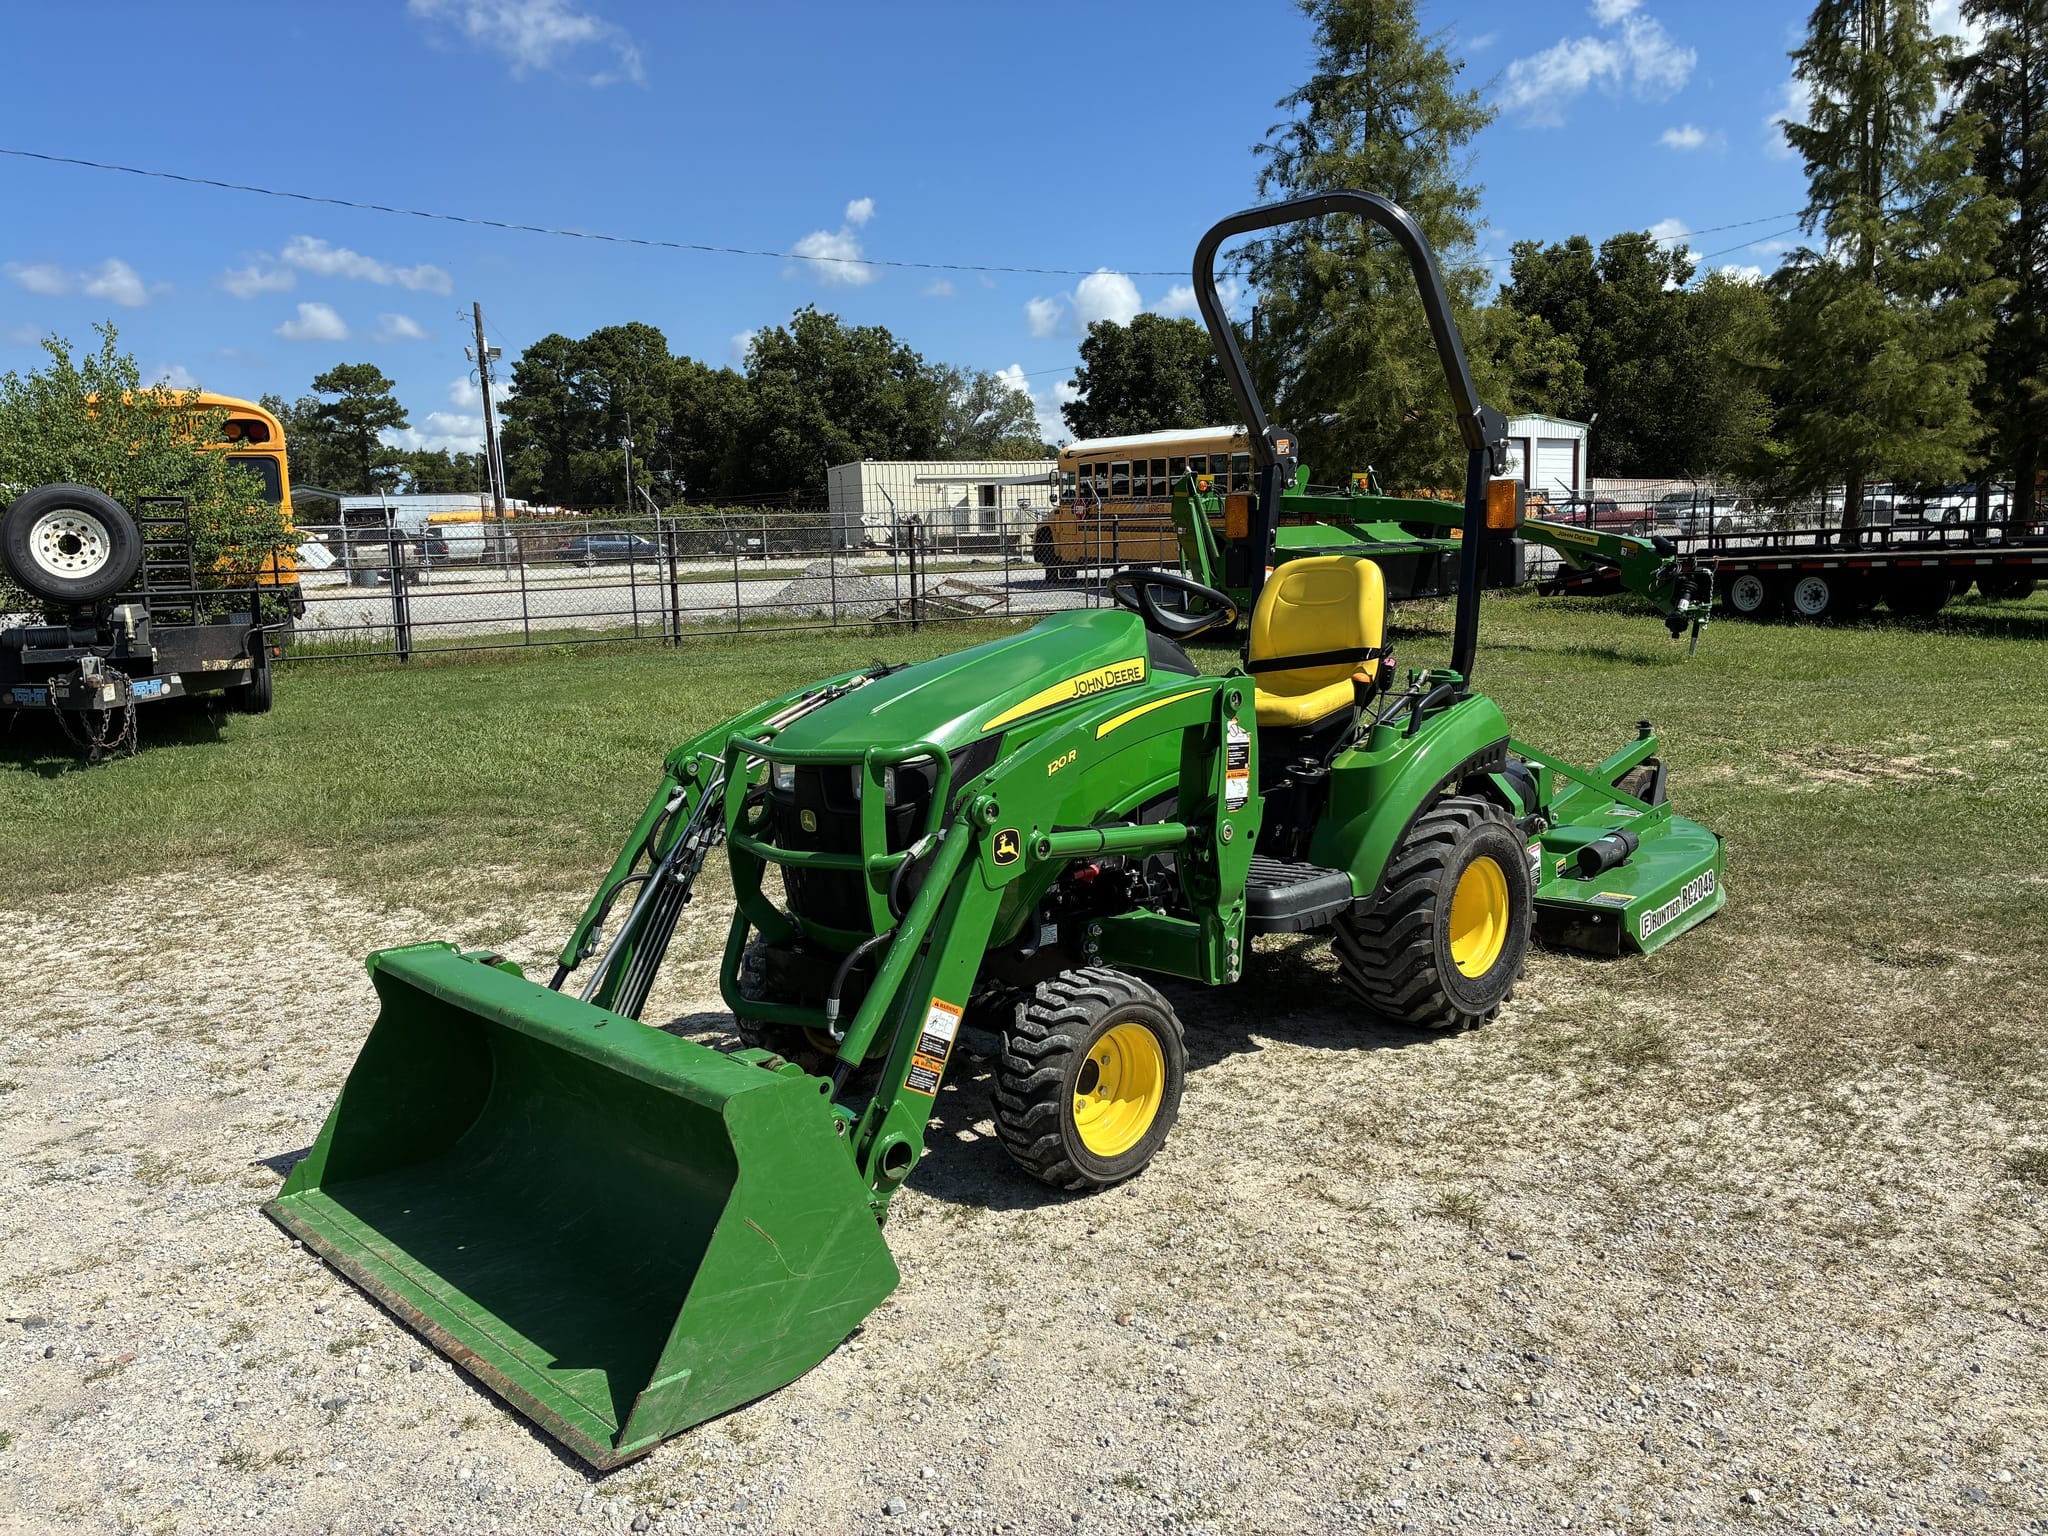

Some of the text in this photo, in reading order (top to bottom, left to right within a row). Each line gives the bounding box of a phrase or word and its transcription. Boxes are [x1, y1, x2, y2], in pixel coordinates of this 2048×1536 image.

[1557, 530, 1595, 543] JOHN DEERE
[1072, 666, 1141, 697] JOHN DEERE
[1682, 870, 1714, 910] RC2048
